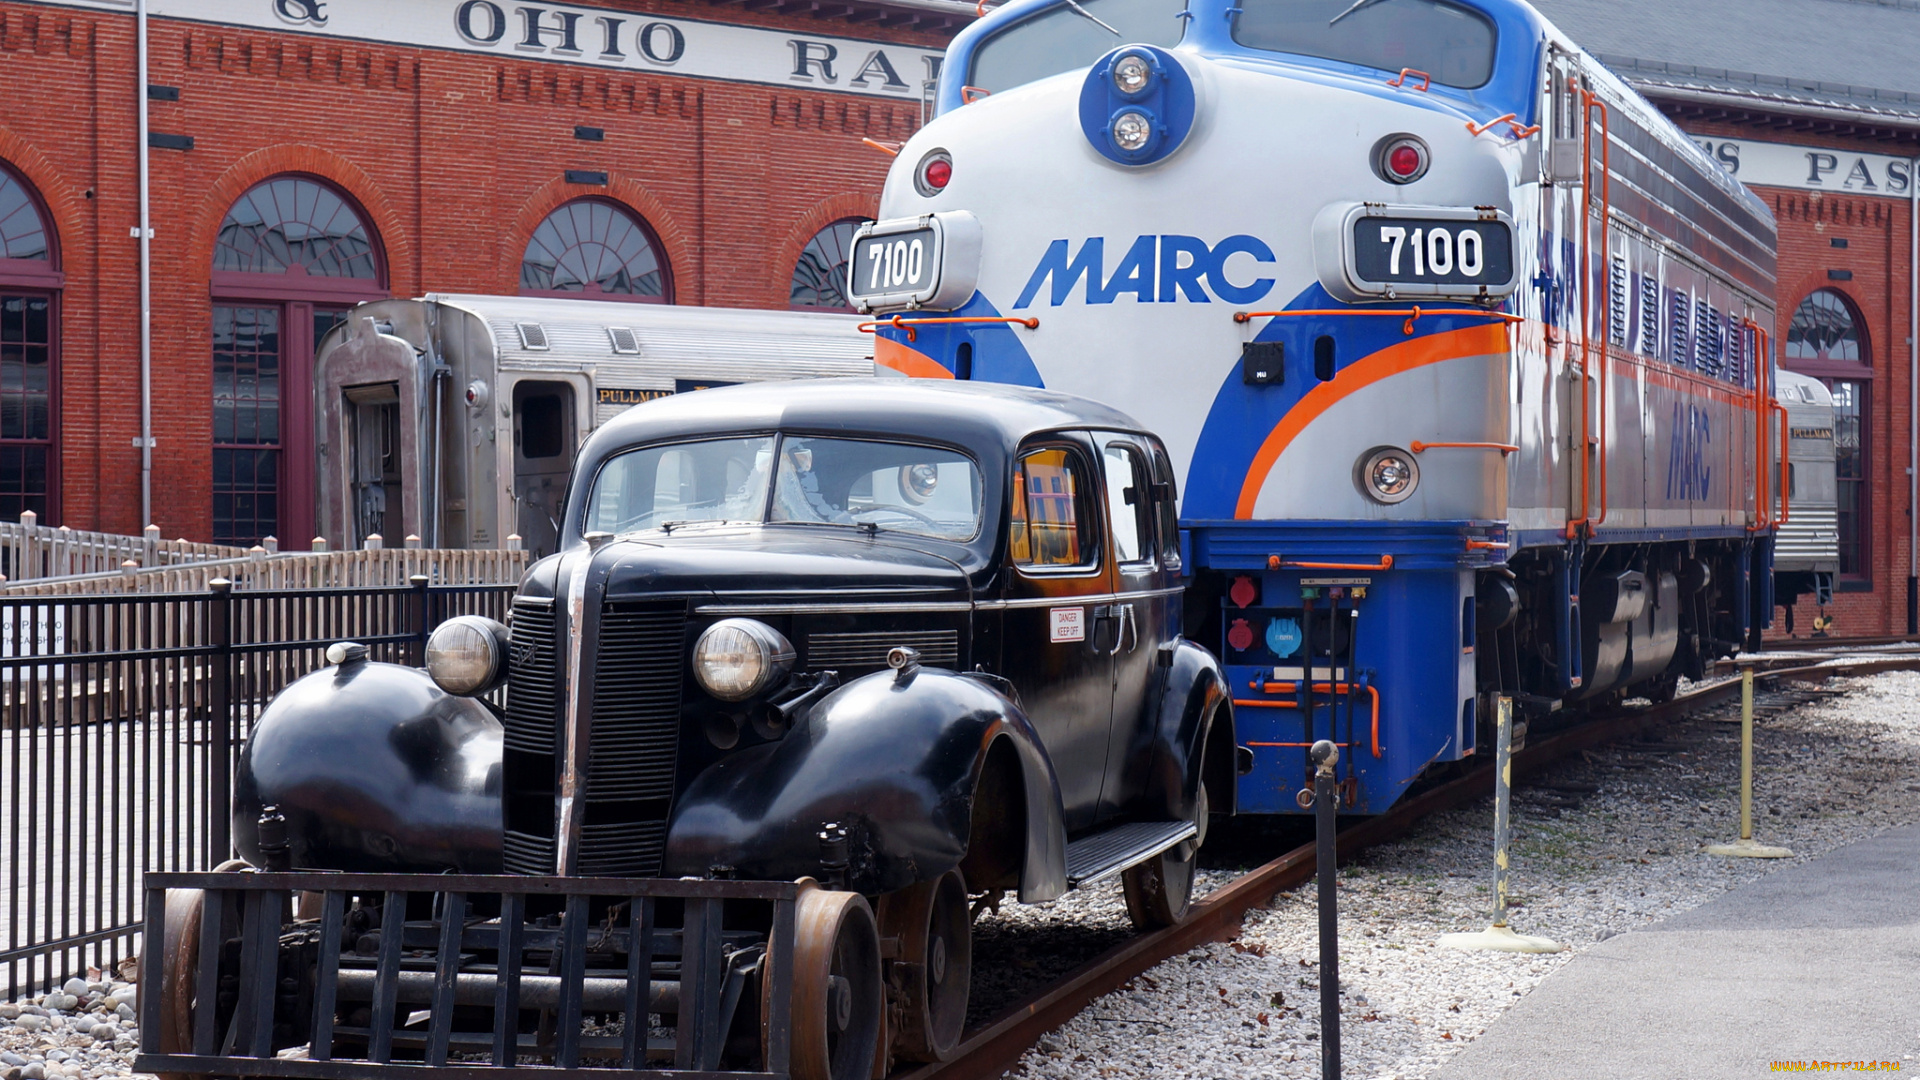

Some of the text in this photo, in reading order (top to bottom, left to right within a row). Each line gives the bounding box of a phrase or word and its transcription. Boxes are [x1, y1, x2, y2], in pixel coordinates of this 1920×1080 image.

[454, 0, 686, 67] OHIO
[1805, 152, 1920, 193] PAS
[869, 238, 923, 289] 7100
[1012, 234, 1277, 309] MARC
[1380, 226, 1484, 277] 7100
[1667, 401, 1710, 502] MARC
[1793, 428, 1831, 438] PULLMAN
[1057, 625, 1079, 637] KEEP OFF
[1058, 612, 1077, 623] DANGER
